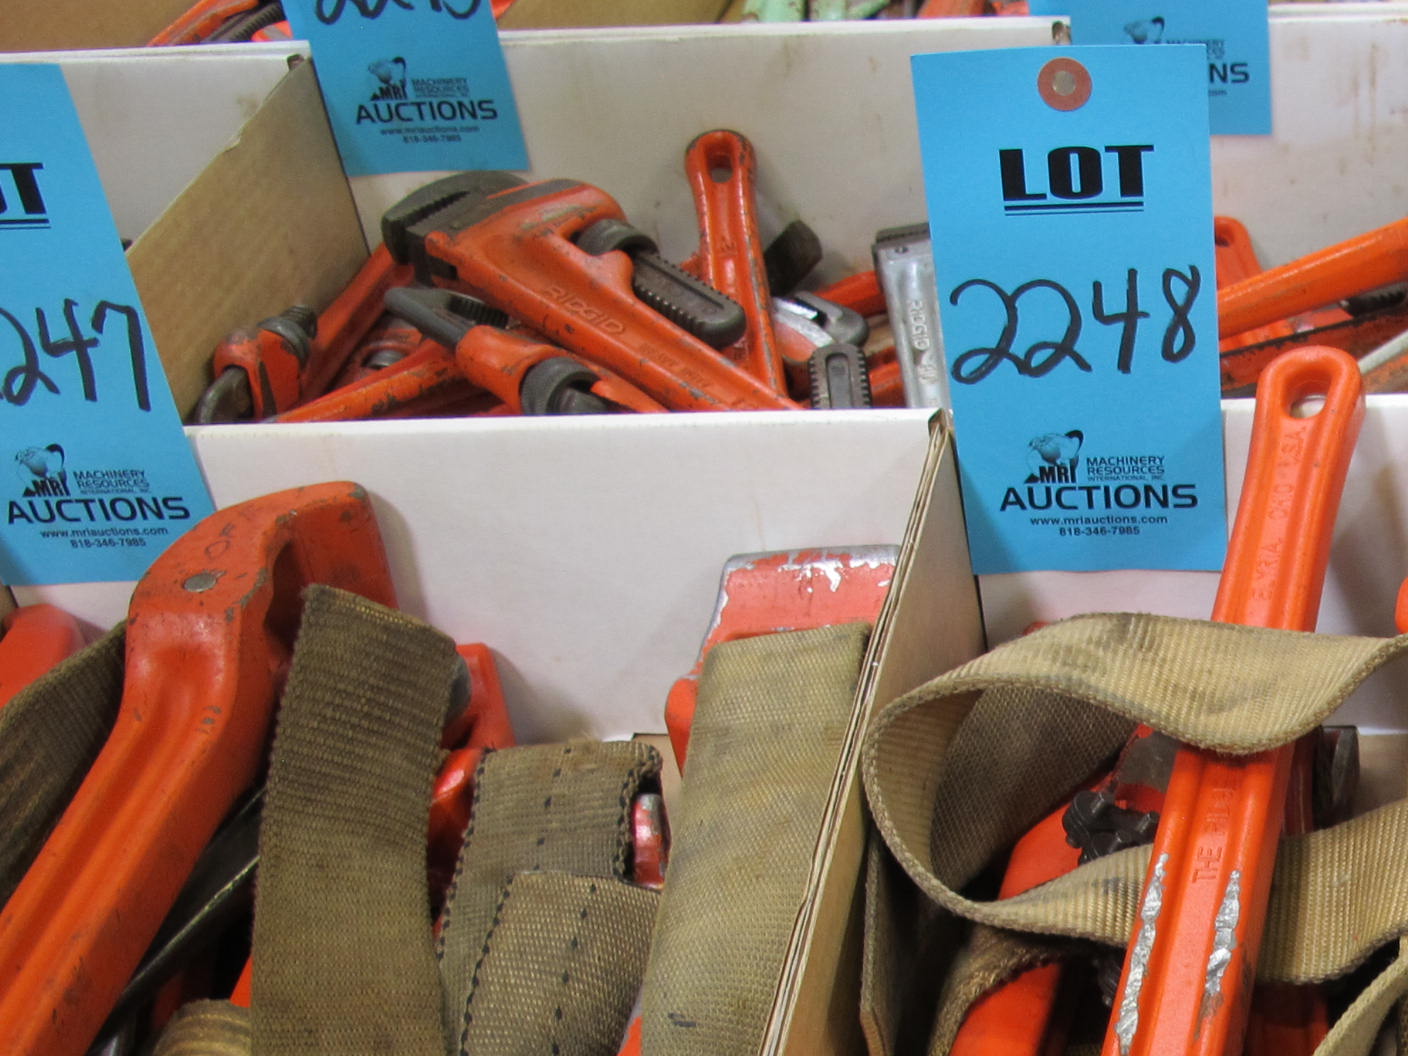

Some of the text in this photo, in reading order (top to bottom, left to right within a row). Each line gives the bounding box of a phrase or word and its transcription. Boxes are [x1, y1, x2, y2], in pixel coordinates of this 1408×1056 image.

[356, 99, 498, 124] AUCTIONS
[999, 145, 1154, 201] LOT
[544, 285, 624, 336] RIDGID
[950, 264, 1201, 385] 2248
[0, 299, 151, 412] 247
[1086, 456, 1165, 466] MACHINERY
[1087, 466, 1165, 475] RESOURCES
[73, 469, 145, 480] MACHINERY
[77, 478, 150, 489] RESOURCES
[1039, 465, 1076, 483] MRI
[32, 477, 71, 497] MRI
[1000, 484, 1198, 511] AUCTIONS
[8, 497, 190, 524] AUCTIONS
[1030, 515, 1168, 526] www.mriauctions.com
[41, 526, 168, 539] www.mriauctions.com
[1059, 526, 1140, 536] 818-346-7985
[70, 538, 147, 549] 818-346-7985
[1192, 847, 1222, 883] THE
